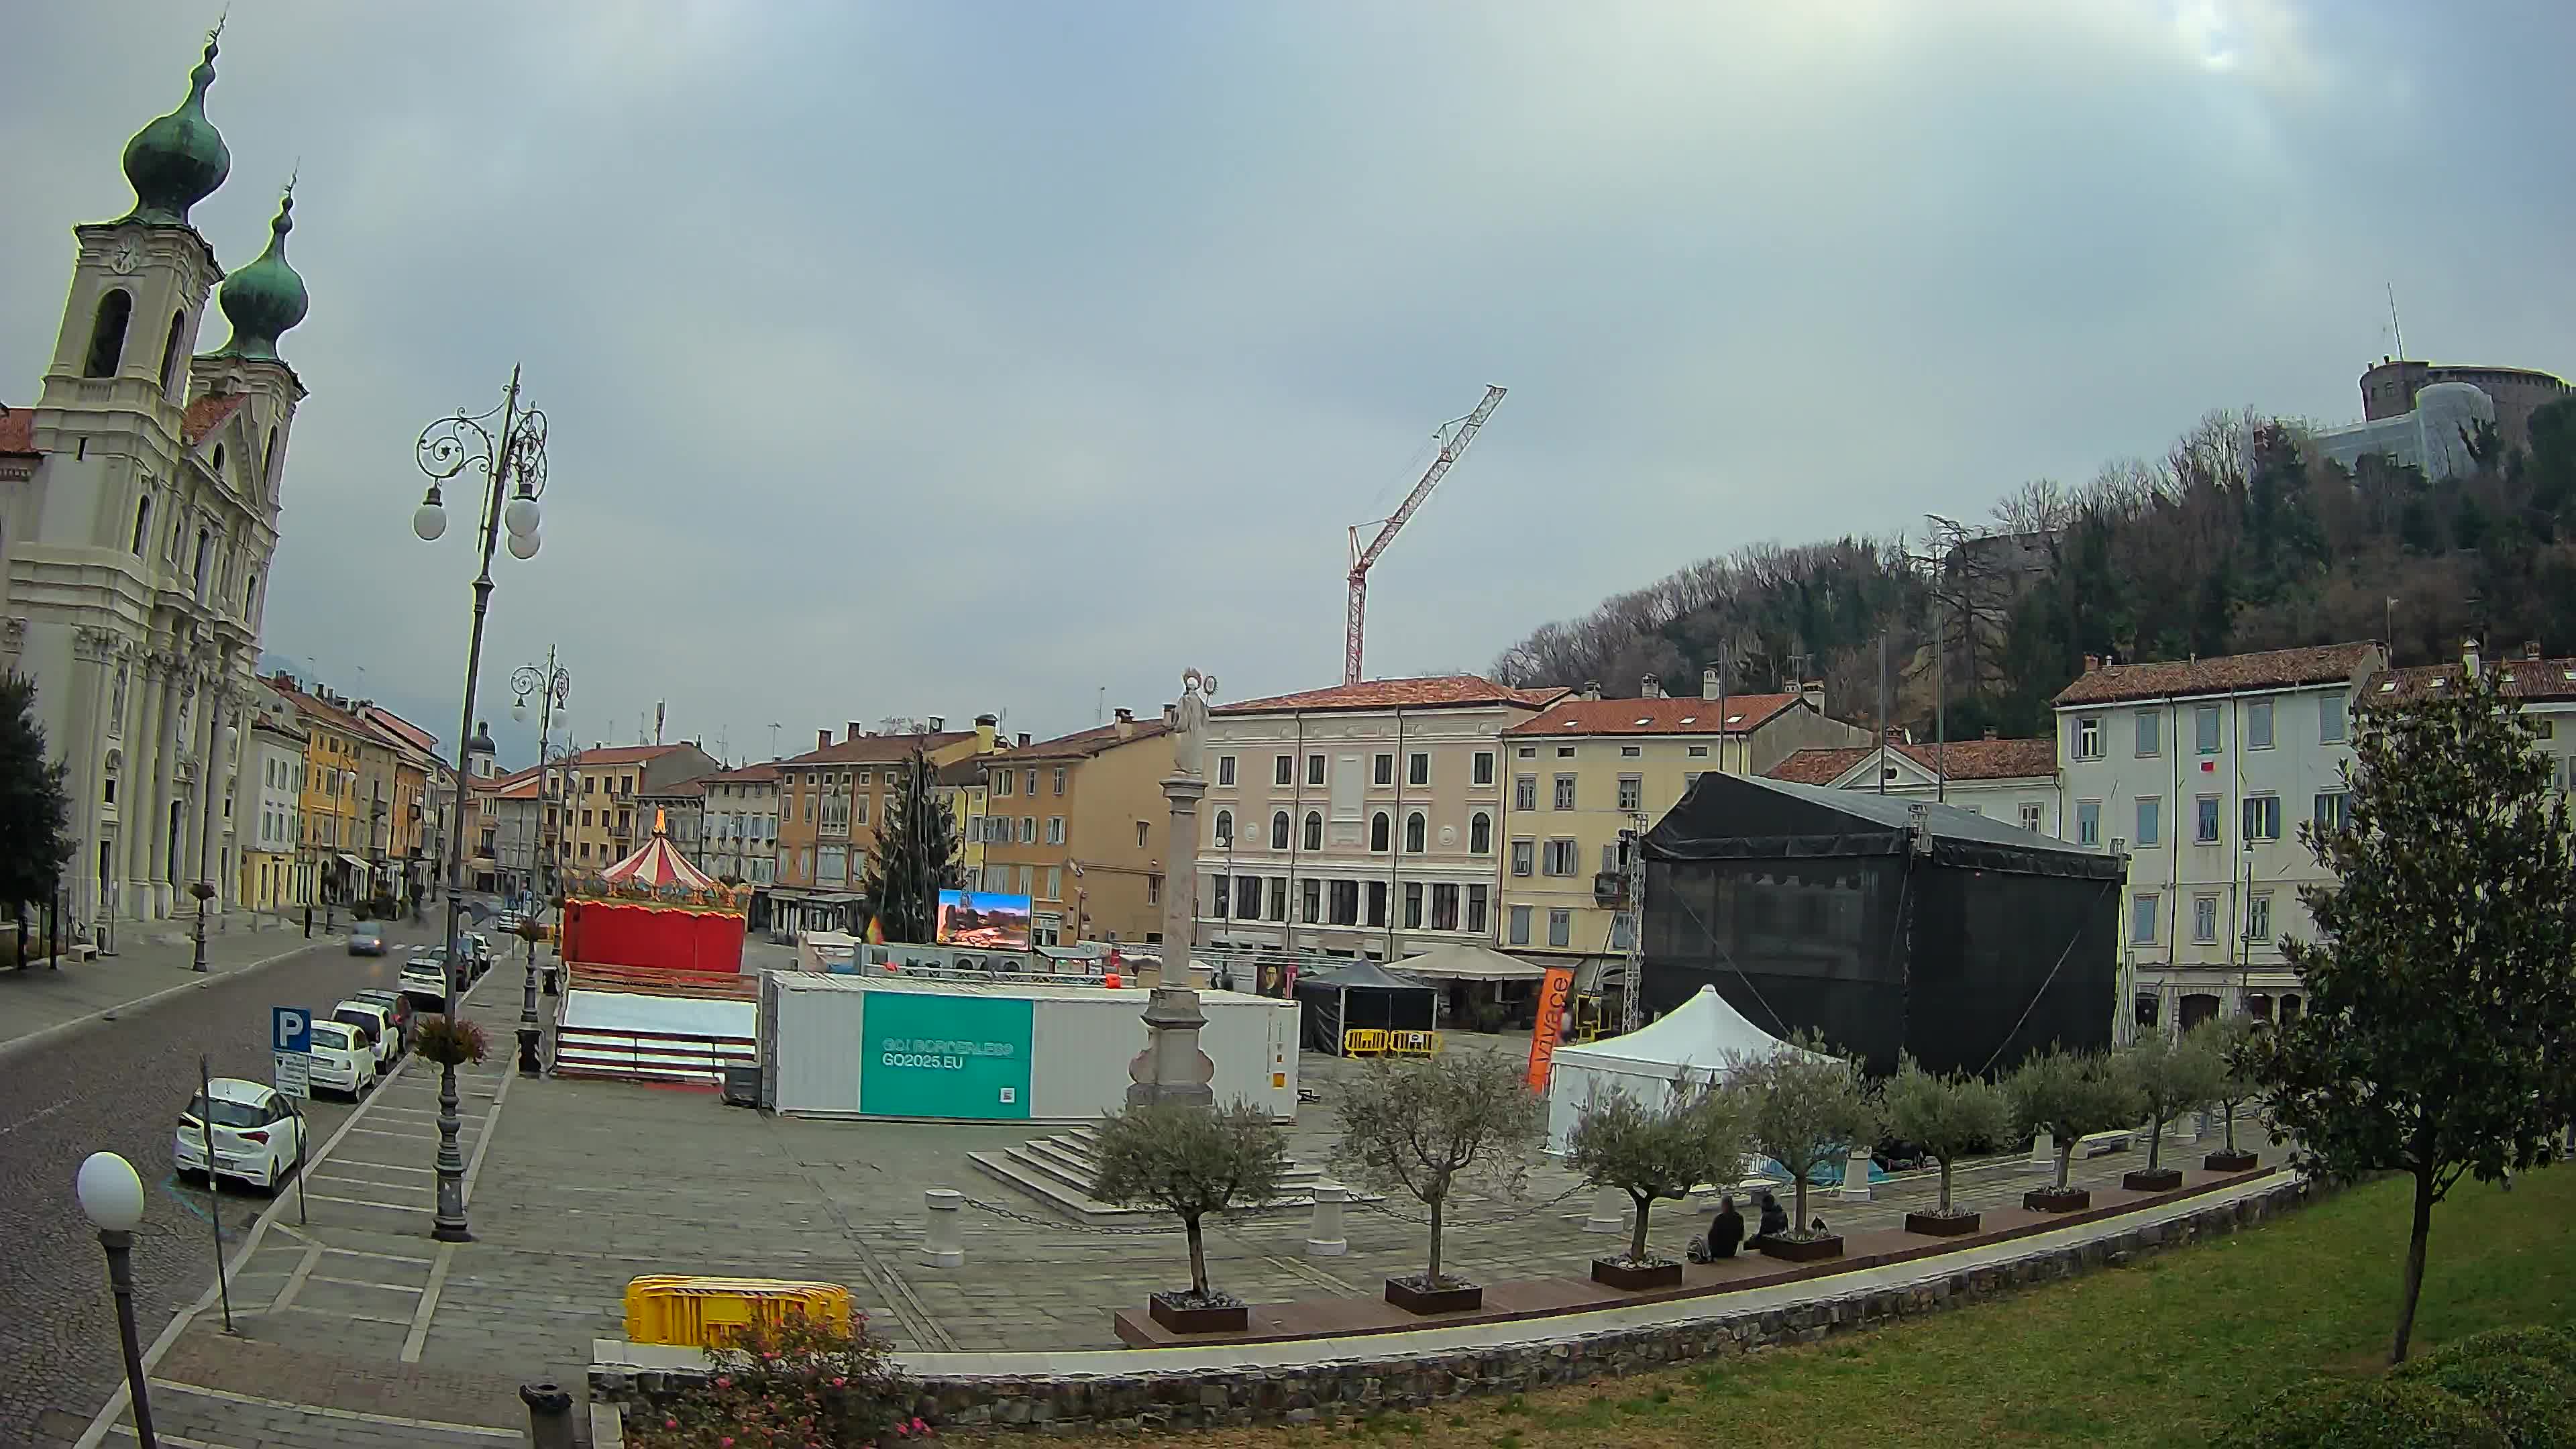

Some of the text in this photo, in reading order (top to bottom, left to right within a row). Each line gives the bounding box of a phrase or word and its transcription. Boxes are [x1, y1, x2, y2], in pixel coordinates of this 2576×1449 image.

[279, 1011, 303, 1047] P
[883, 1038, 1014, 1056] GO! BORDERLESS
[882, 1053, 963, 1069] GO2025.EU
